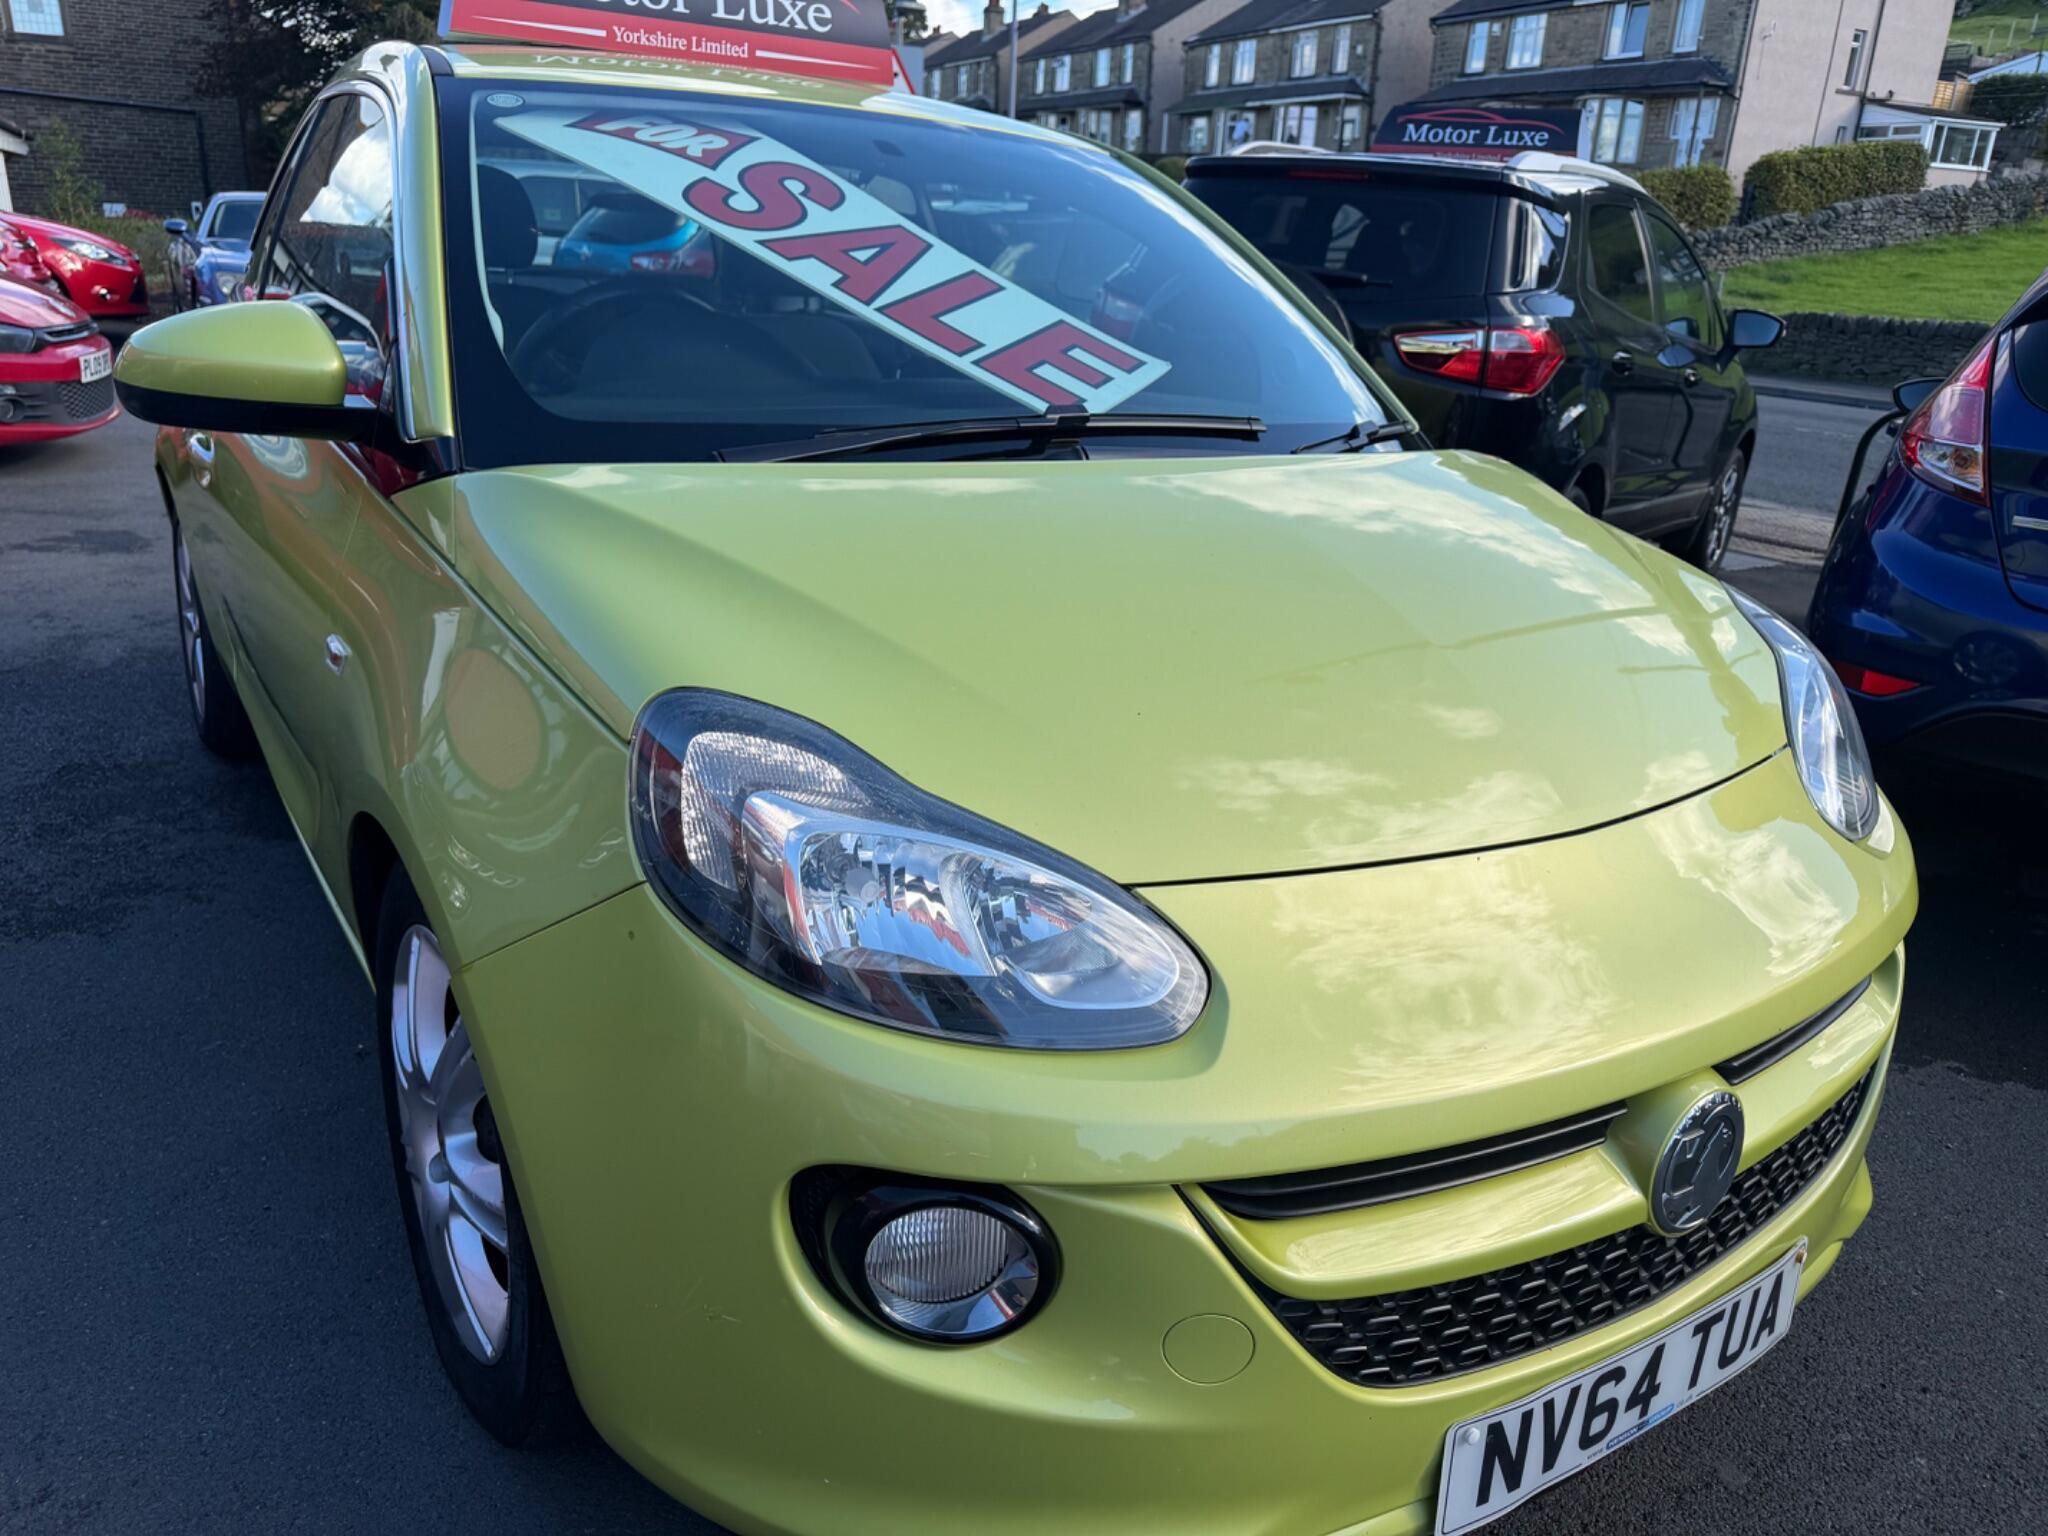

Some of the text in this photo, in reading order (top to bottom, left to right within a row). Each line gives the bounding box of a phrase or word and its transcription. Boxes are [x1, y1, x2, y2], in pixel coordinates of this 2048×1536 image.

[612, 25, 687, 50] Yorkshire
[691, 36, 749, 58] Limited
[594, 115, 729, 157] FOR
[1402, 123, 1549, 147] Motor Luxe
[682, 161, 1146, 405] SALE
[1476, 1271, 1784, 1507] NV64 TUA
